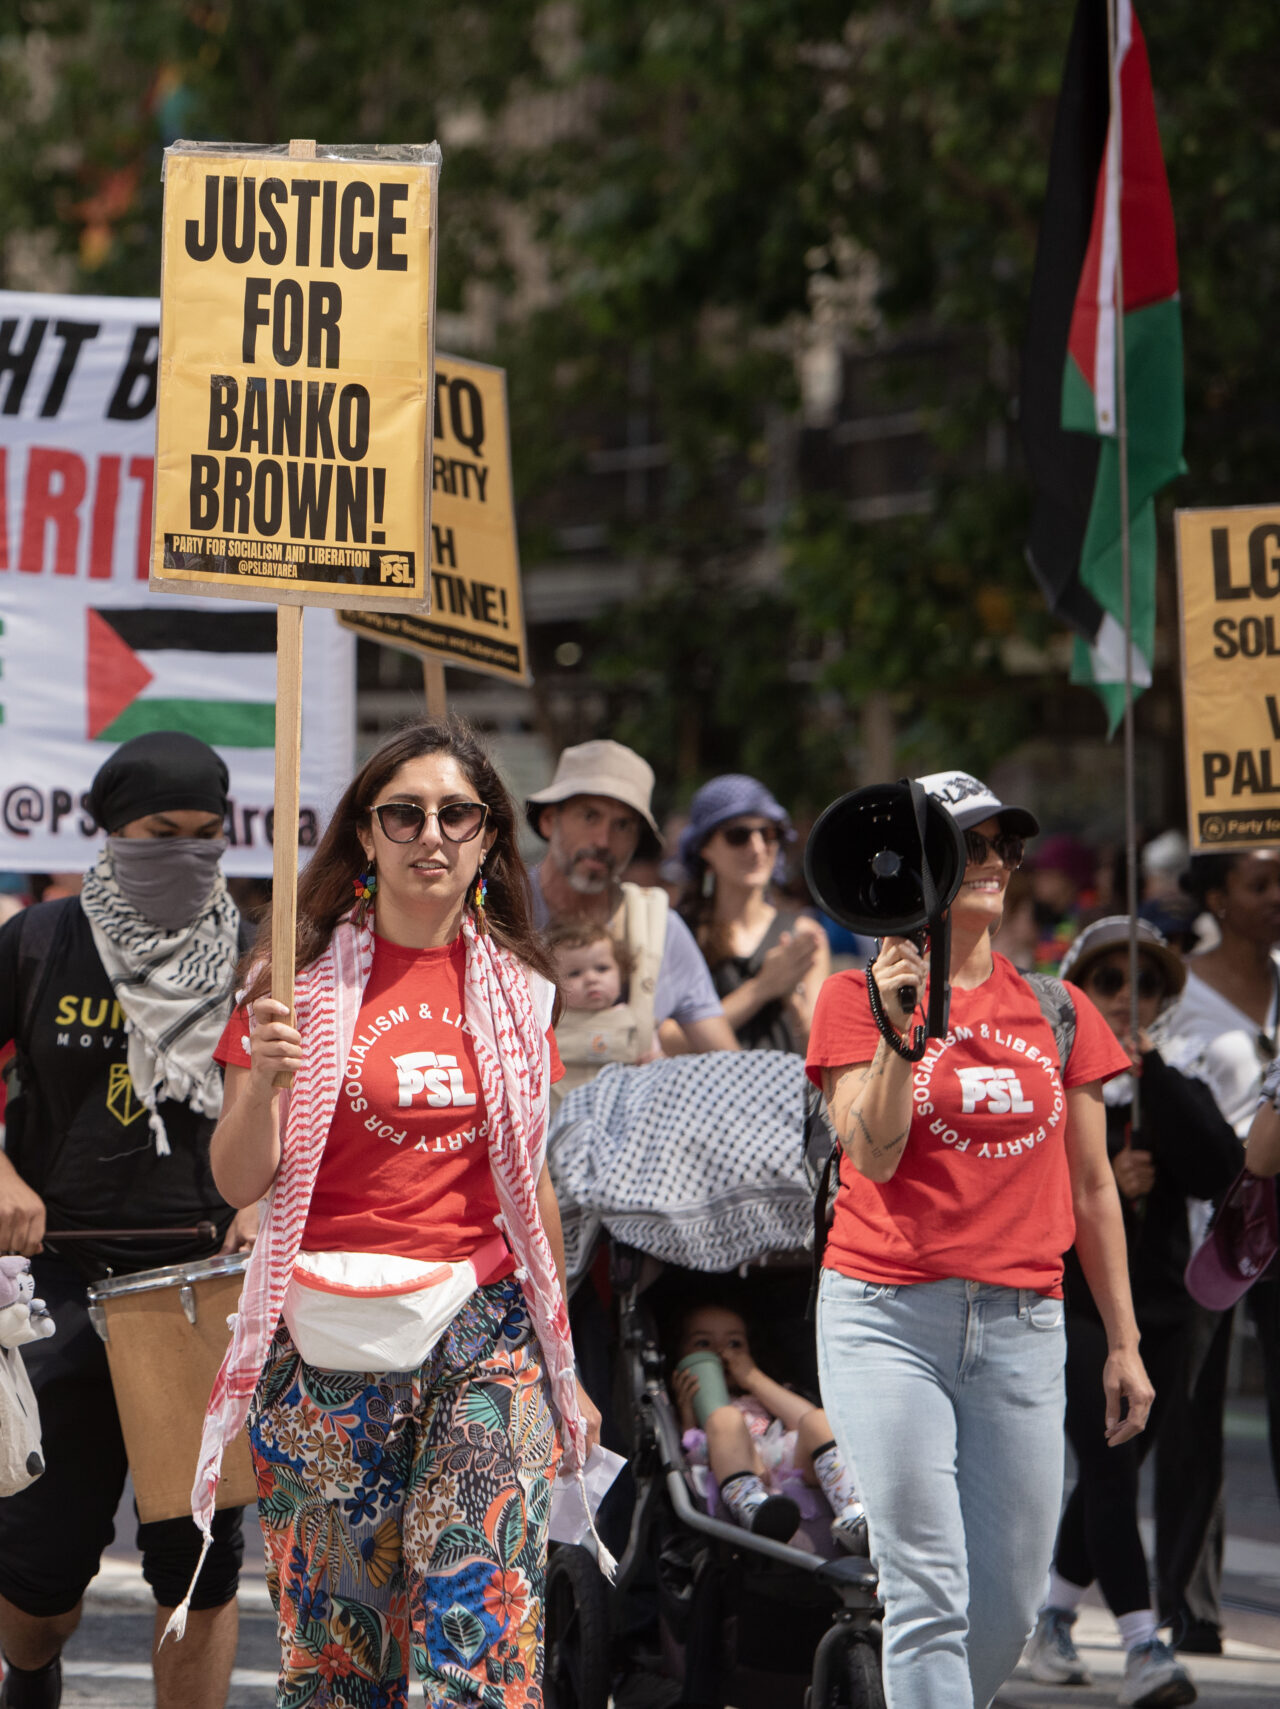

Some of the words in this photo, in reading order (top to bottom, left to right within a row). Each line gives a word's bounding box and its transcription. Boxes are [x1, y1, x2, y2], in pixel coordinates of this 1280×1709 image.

[185, 175, 409, 271] JUSTICE
[242, 277, 342, 369] FOR
[207, 374, 370, 461] BANKO
[190, 454, 387, 544] BROWN!
[173, 535, 204, 553] PARTY
[206, 538, 227, 555] FOR
[227, 540, 283, 562] SOCIALISM
[285, 545, 306, 564] AND
[308, 546, 370, 568] LIBERATION
[238, 559, 298, 578] @PSLBAYAREA
[380, 560, 414, 584] PSL
[418, 1003, 433, 1020] &
[980, 1023, 990, 1039] &
[345, 1005, 409, 1113] SOCIALISM
[913, 1026, 974, 1116] SOCIALISM
[396, 1067, 477, 1107] PSL
[959, 1078, 1034, 1114] PSL
[995, 1029, 1064, 1128] LIBERATION
[363, 1114, 408, 1145] FOR
[414, 1119, 490, 1153] PARTY
[929, 1117, 971, 1153] FOR
[977, 1126, 1047, 1159] PARTY
